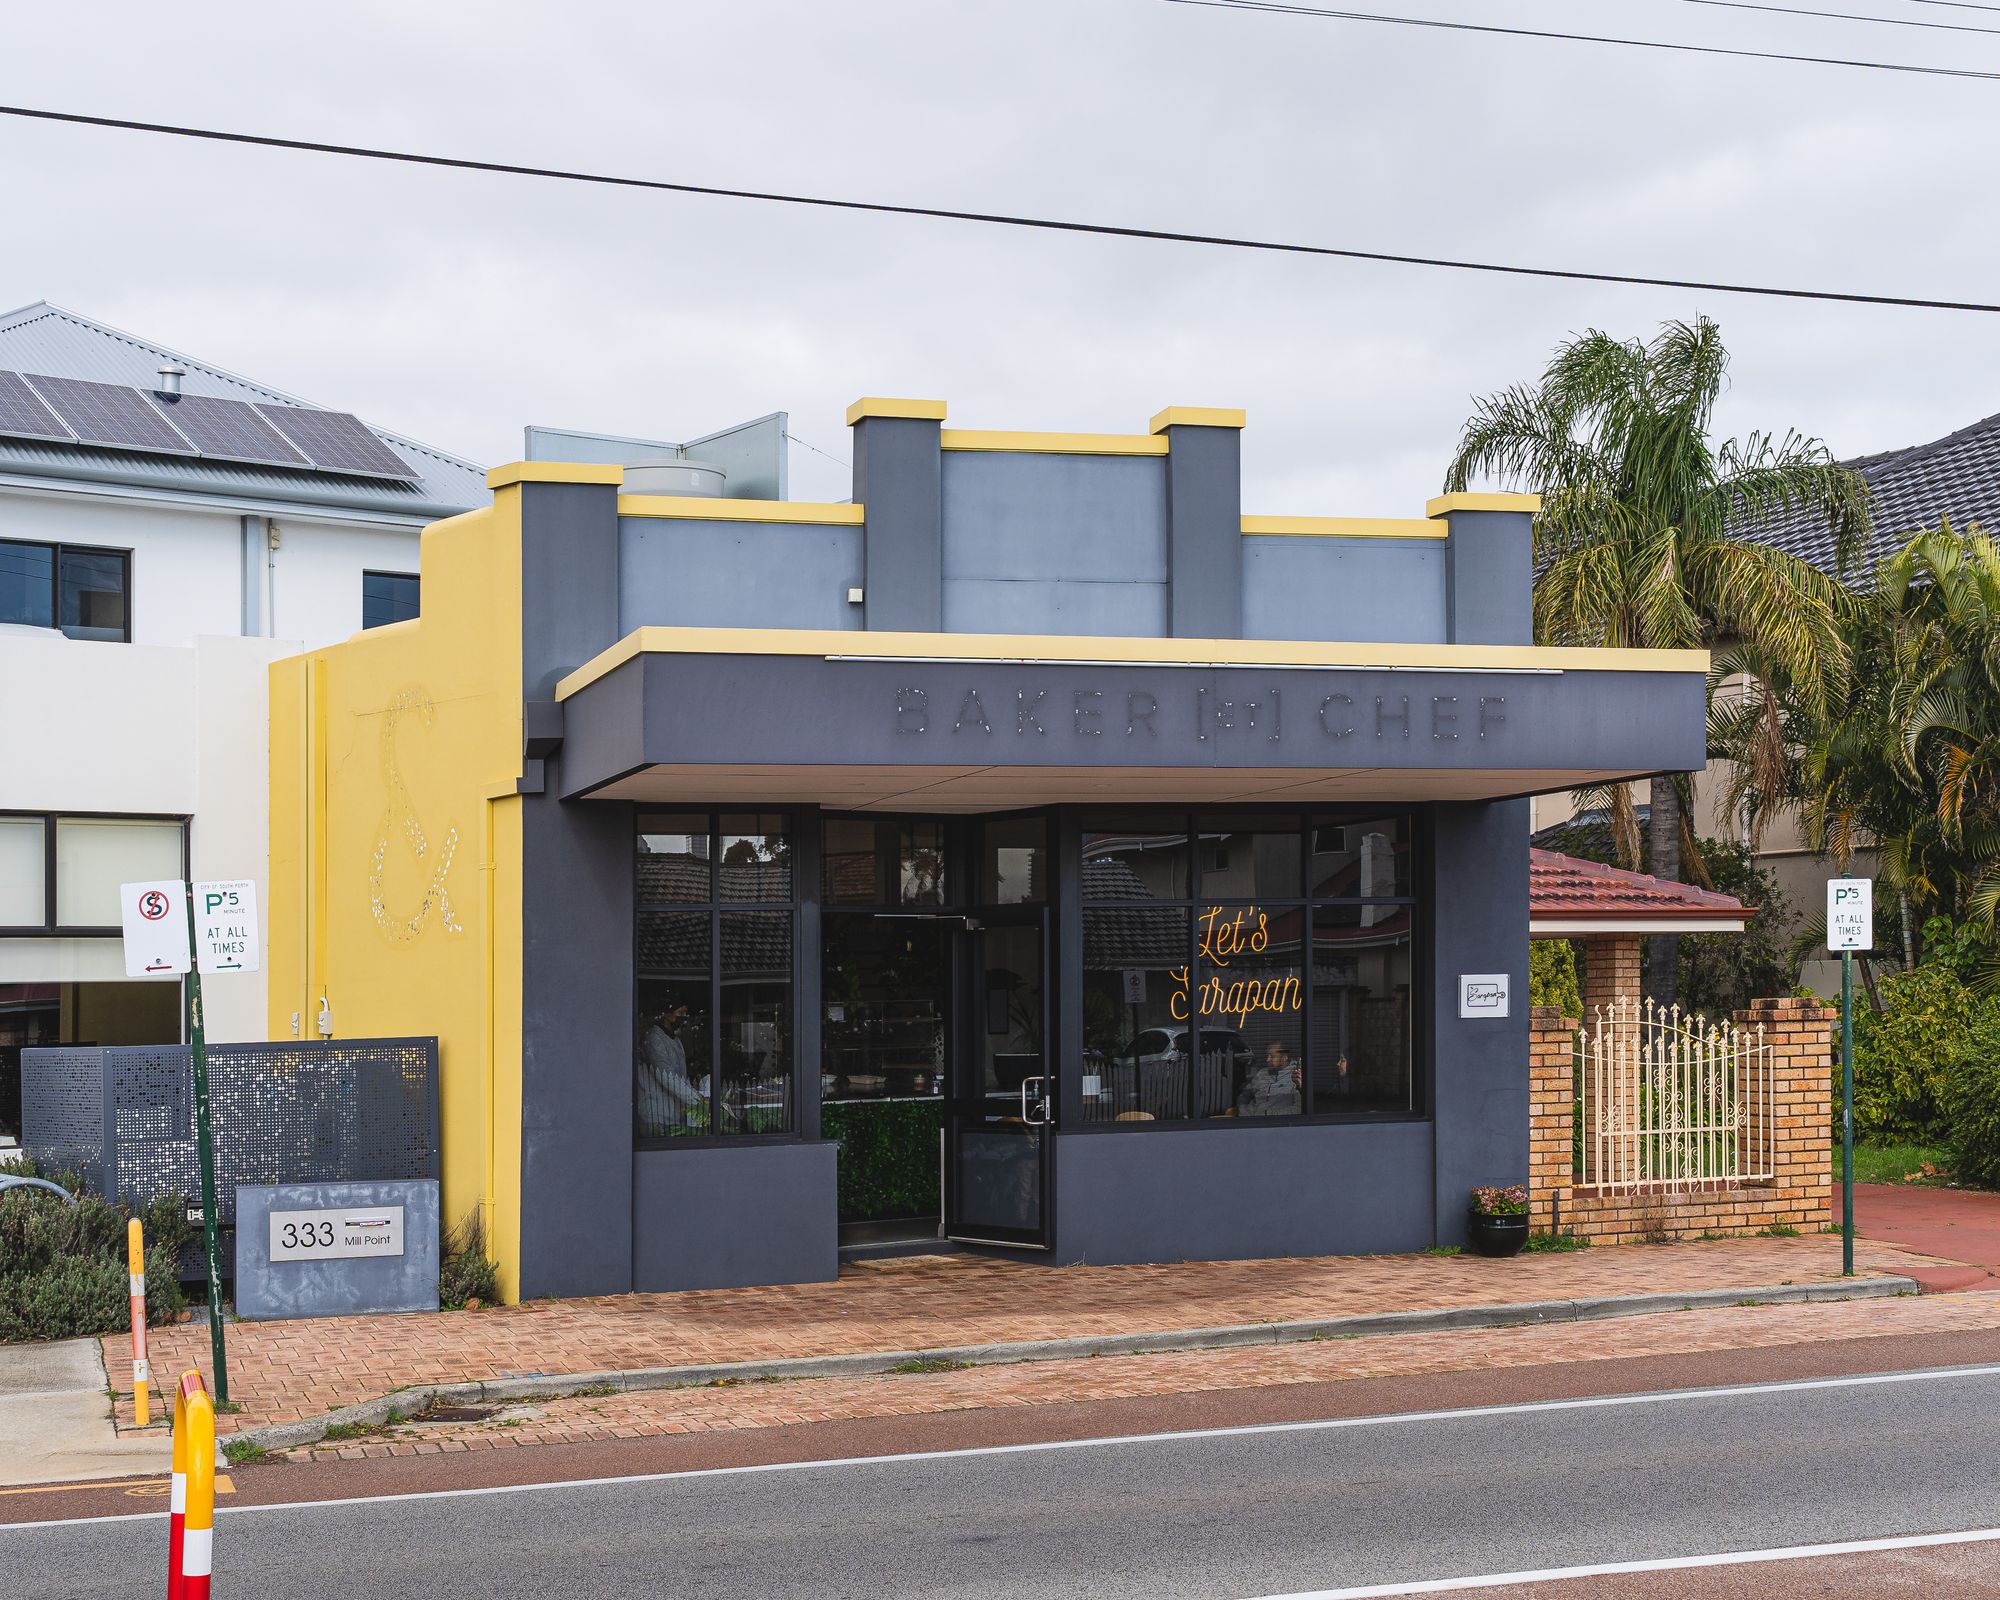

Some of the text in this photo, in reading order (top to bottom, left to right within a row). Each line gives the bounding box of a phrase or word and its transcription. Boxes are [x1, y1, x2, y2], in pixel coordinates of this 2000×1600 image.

[895, 687, 1159, 736] BAKER
[1320, 693, 1505, 739] CHEF
[206, 892, 239, 914] P 5
[1836, 889, 1859, 904] P 5
[1835, 915, 1864, 923] AT ALL
[208, 926, 248, 938] AT ALL
[1198, 906, 1267, 966] Let's
[1838, 927, 1861, 935] TIMES
[212, 941, 245, 954] TIMES
[281, 1221, 335, 1249] 333
[344, 1234, 391, 1246] Mill Point
